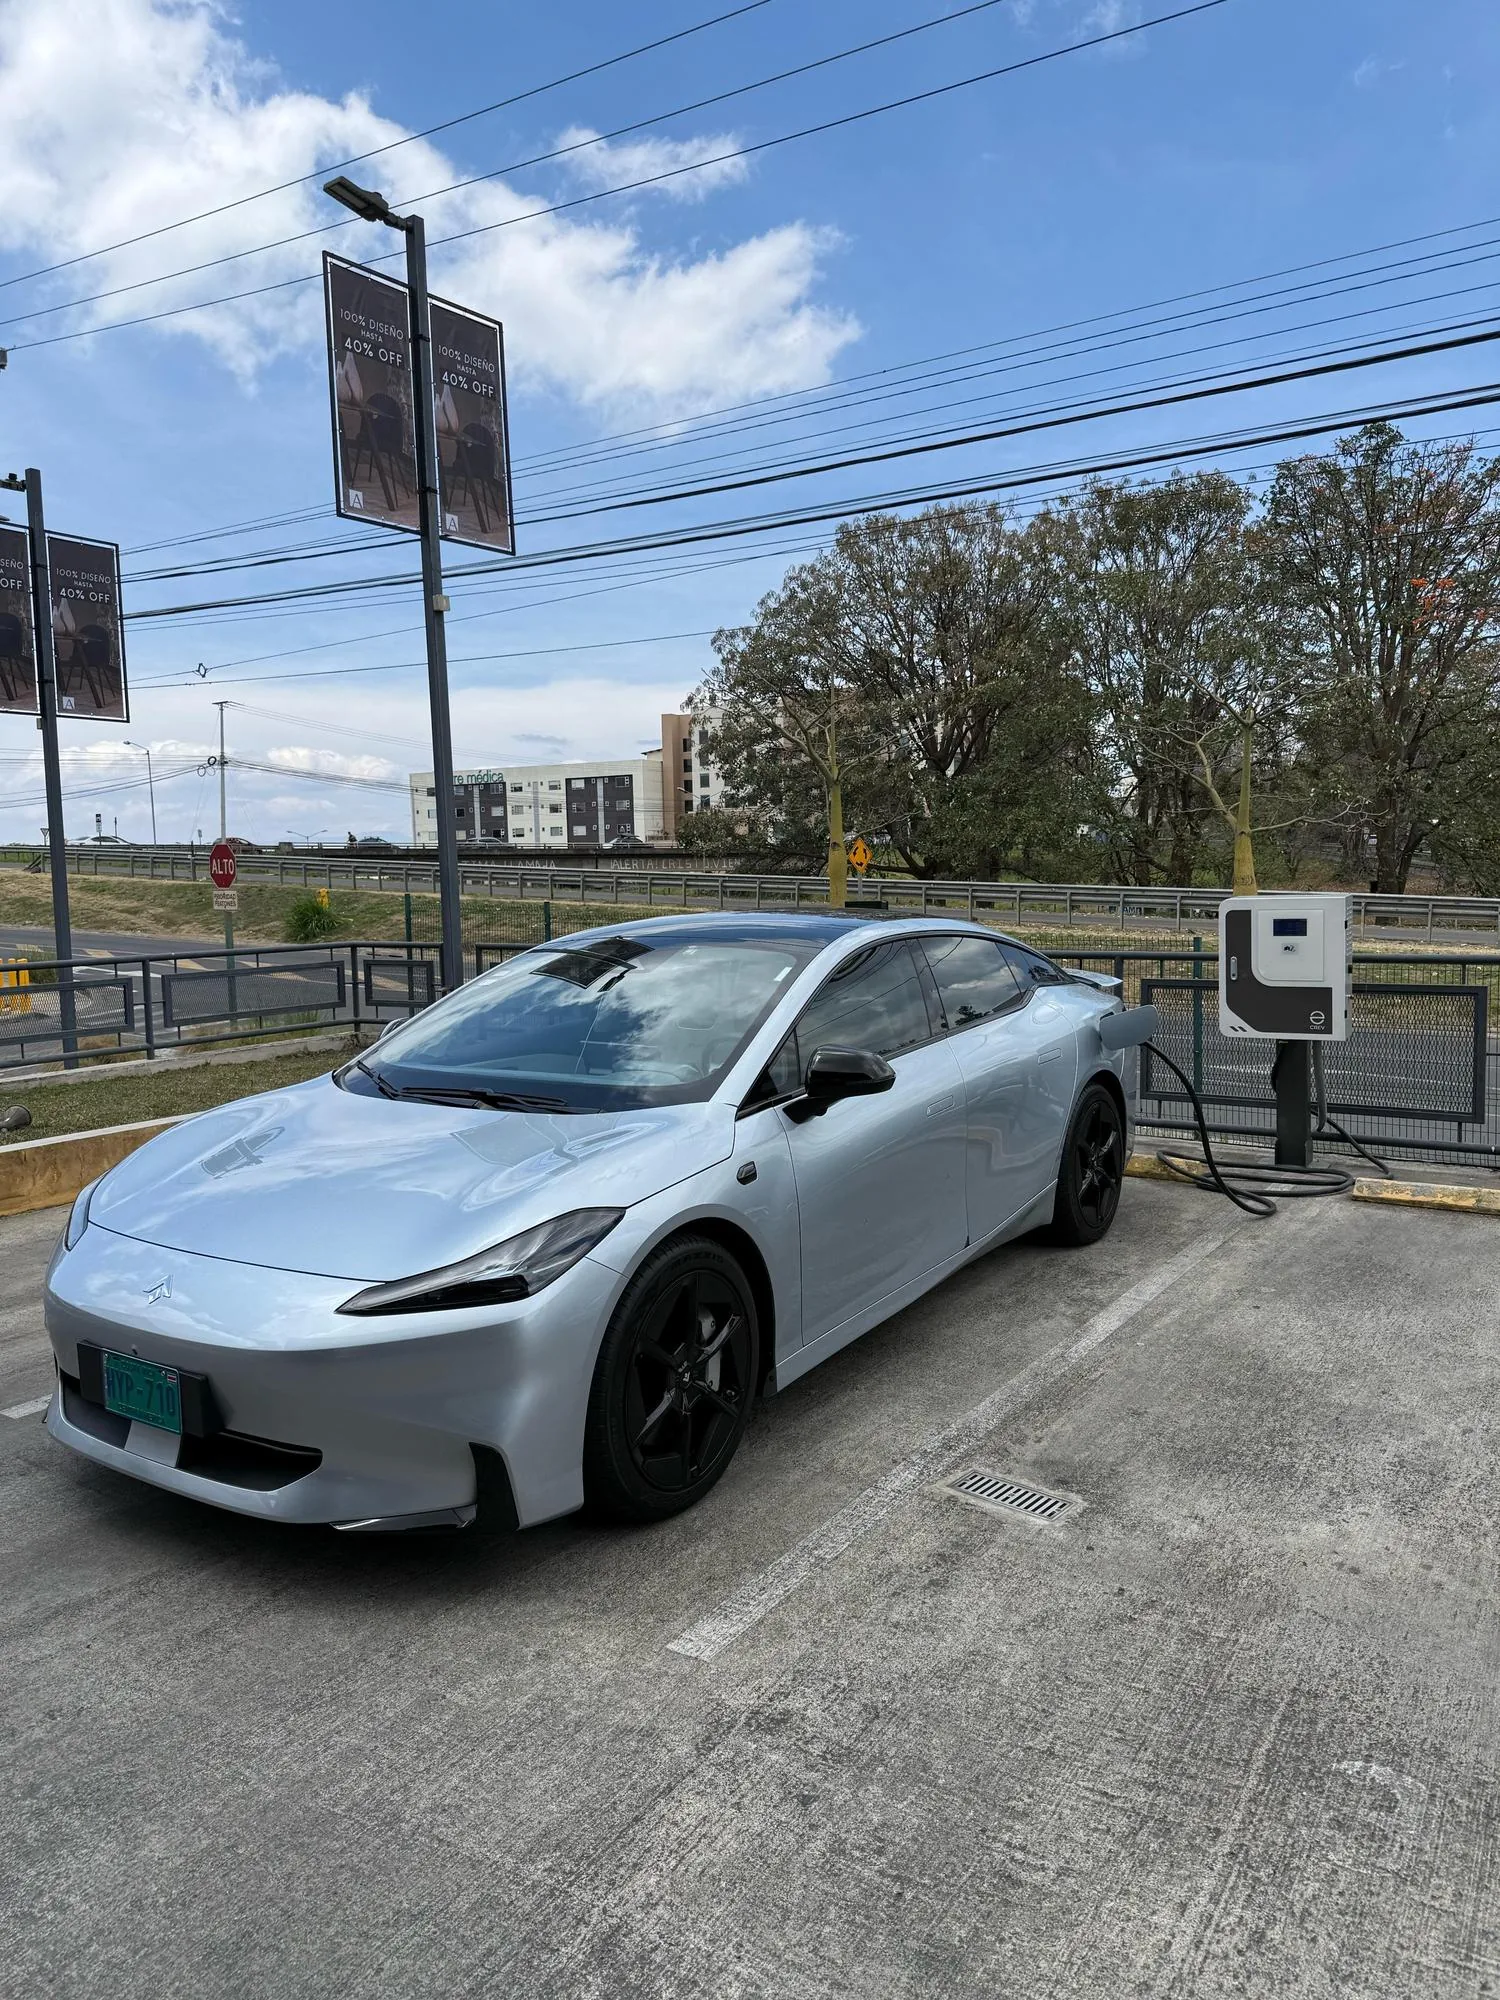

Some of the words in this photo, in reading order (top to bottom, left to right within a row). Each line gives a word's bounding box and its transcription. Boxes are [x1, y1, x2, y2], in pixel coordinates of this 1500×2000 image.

[340, 308, 366, 327] 100%
[368, 319, 404, 341] DISEÑO
[360, 329, 383, 343] HASTA
[344, 336, 374, 358] 40%
[378, 346, 403, 366] OFF
[438, 344, 462, 361] 100%
[464, 354, 495, 374] DISEÑO
[456, 363, 477, 377] HASTA
[442, 371, 468, 390] 40%
[472, 380, 494, 398] OFF
[0, 577, 23, 590] OFF
[56, 567, 78, 579] 100%
[81, 571, 111, 584] DISEÑO
[73, 580, 93, 588] HASTA
[60, 588, 85, 600] 40%
[89, 591, 110, 604] OFF
[466, 769, 504, 784] médica
[212, 859, 234, 874] ALTO
[107, 1367, 176, 1416] HYP-710
